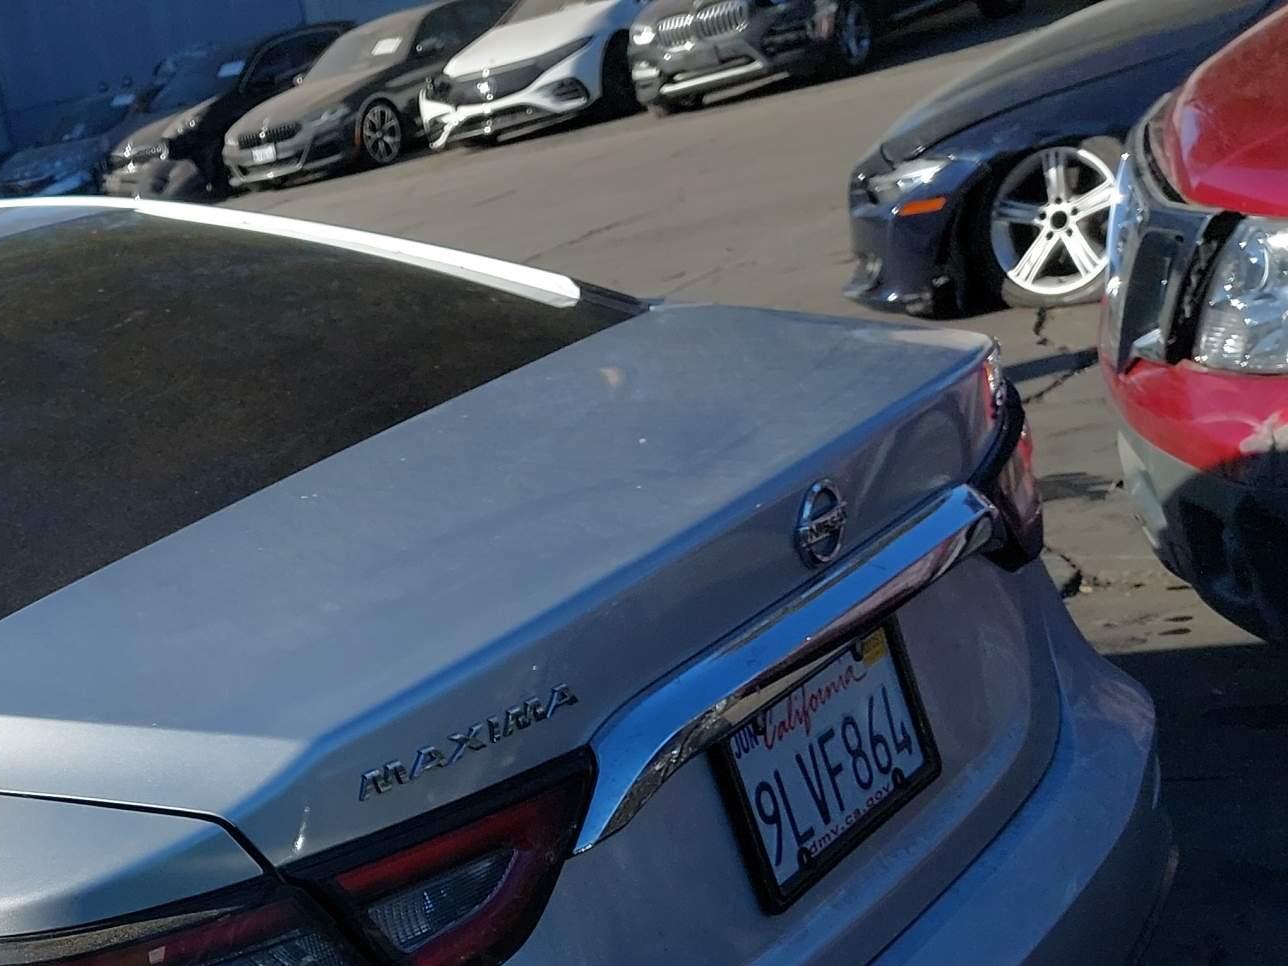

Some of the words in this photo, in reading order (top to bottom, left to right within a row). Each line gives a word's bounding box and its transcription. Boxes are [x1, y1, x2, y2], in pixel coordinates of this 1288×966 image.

[358, 682, 580, 802] MAXIMA
[764, 663, 866, 750] California
[754, 685, 914, 867] 9LVF864
